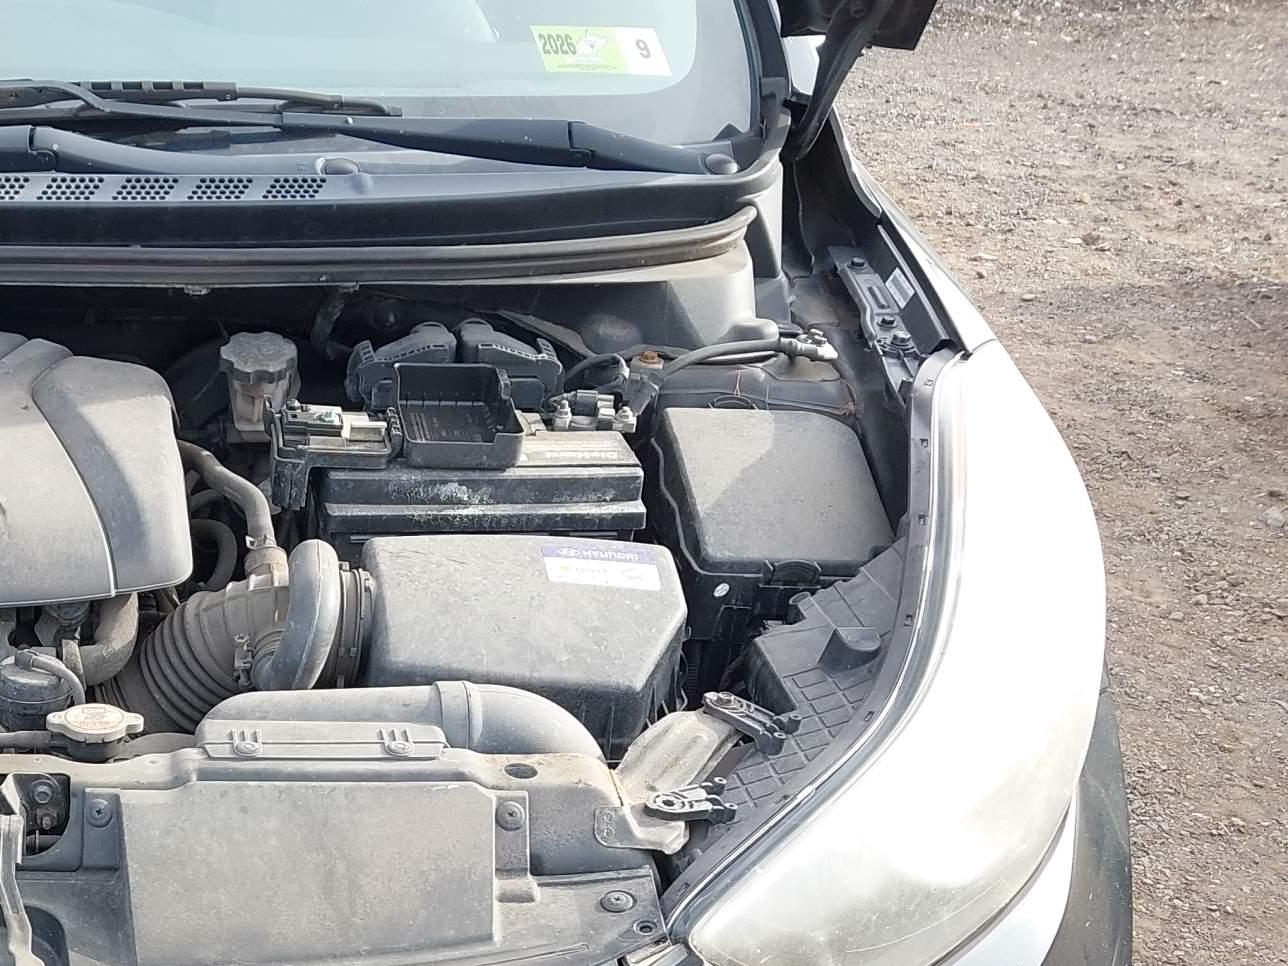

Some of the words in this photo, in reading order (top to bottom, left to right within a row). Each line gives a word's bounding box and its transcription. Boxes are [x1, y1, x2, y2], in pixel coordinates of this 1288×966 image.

[538, 33, 577, 55] 2026
[635, 38, 651, 59] 9
[581, 550, 640, 561] HYUNDAI
